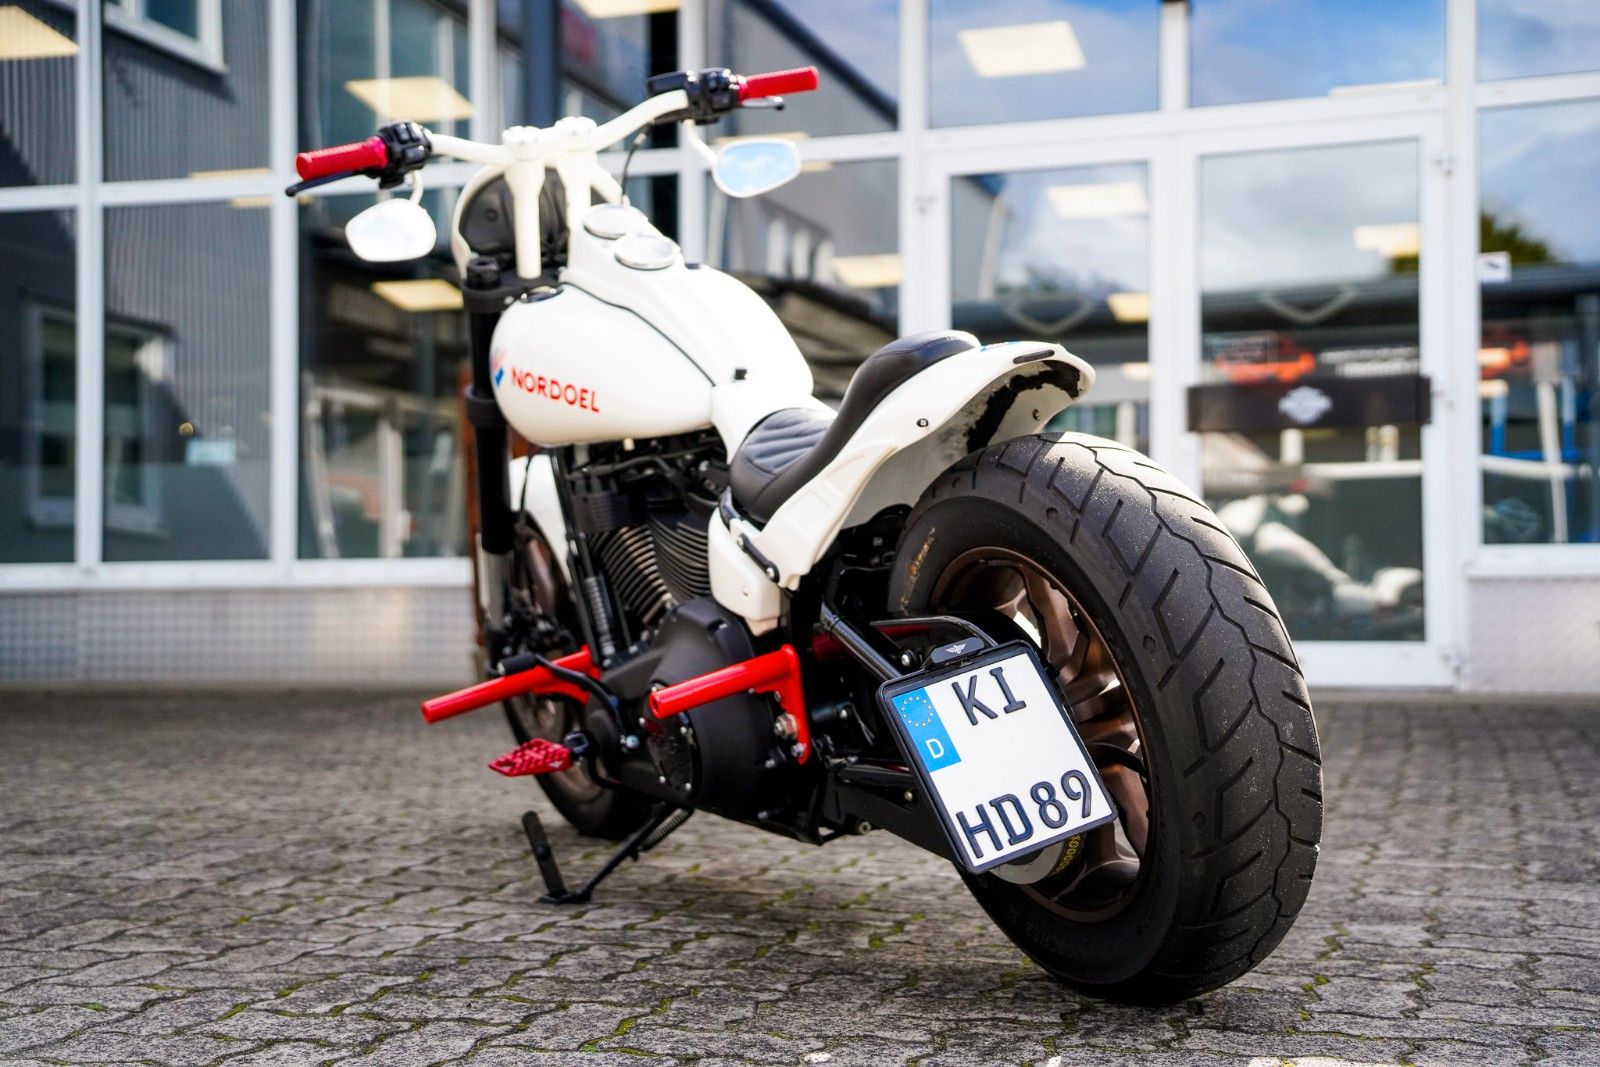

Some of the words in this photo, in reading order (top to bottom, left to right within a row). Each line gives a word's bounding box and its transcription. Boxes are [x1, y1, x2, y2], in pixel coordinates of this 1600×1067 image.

[511, 367, 599, 412] NORDOEL
[951, 666, 1027, 726] KI
[925, 737, 945, 760] D
